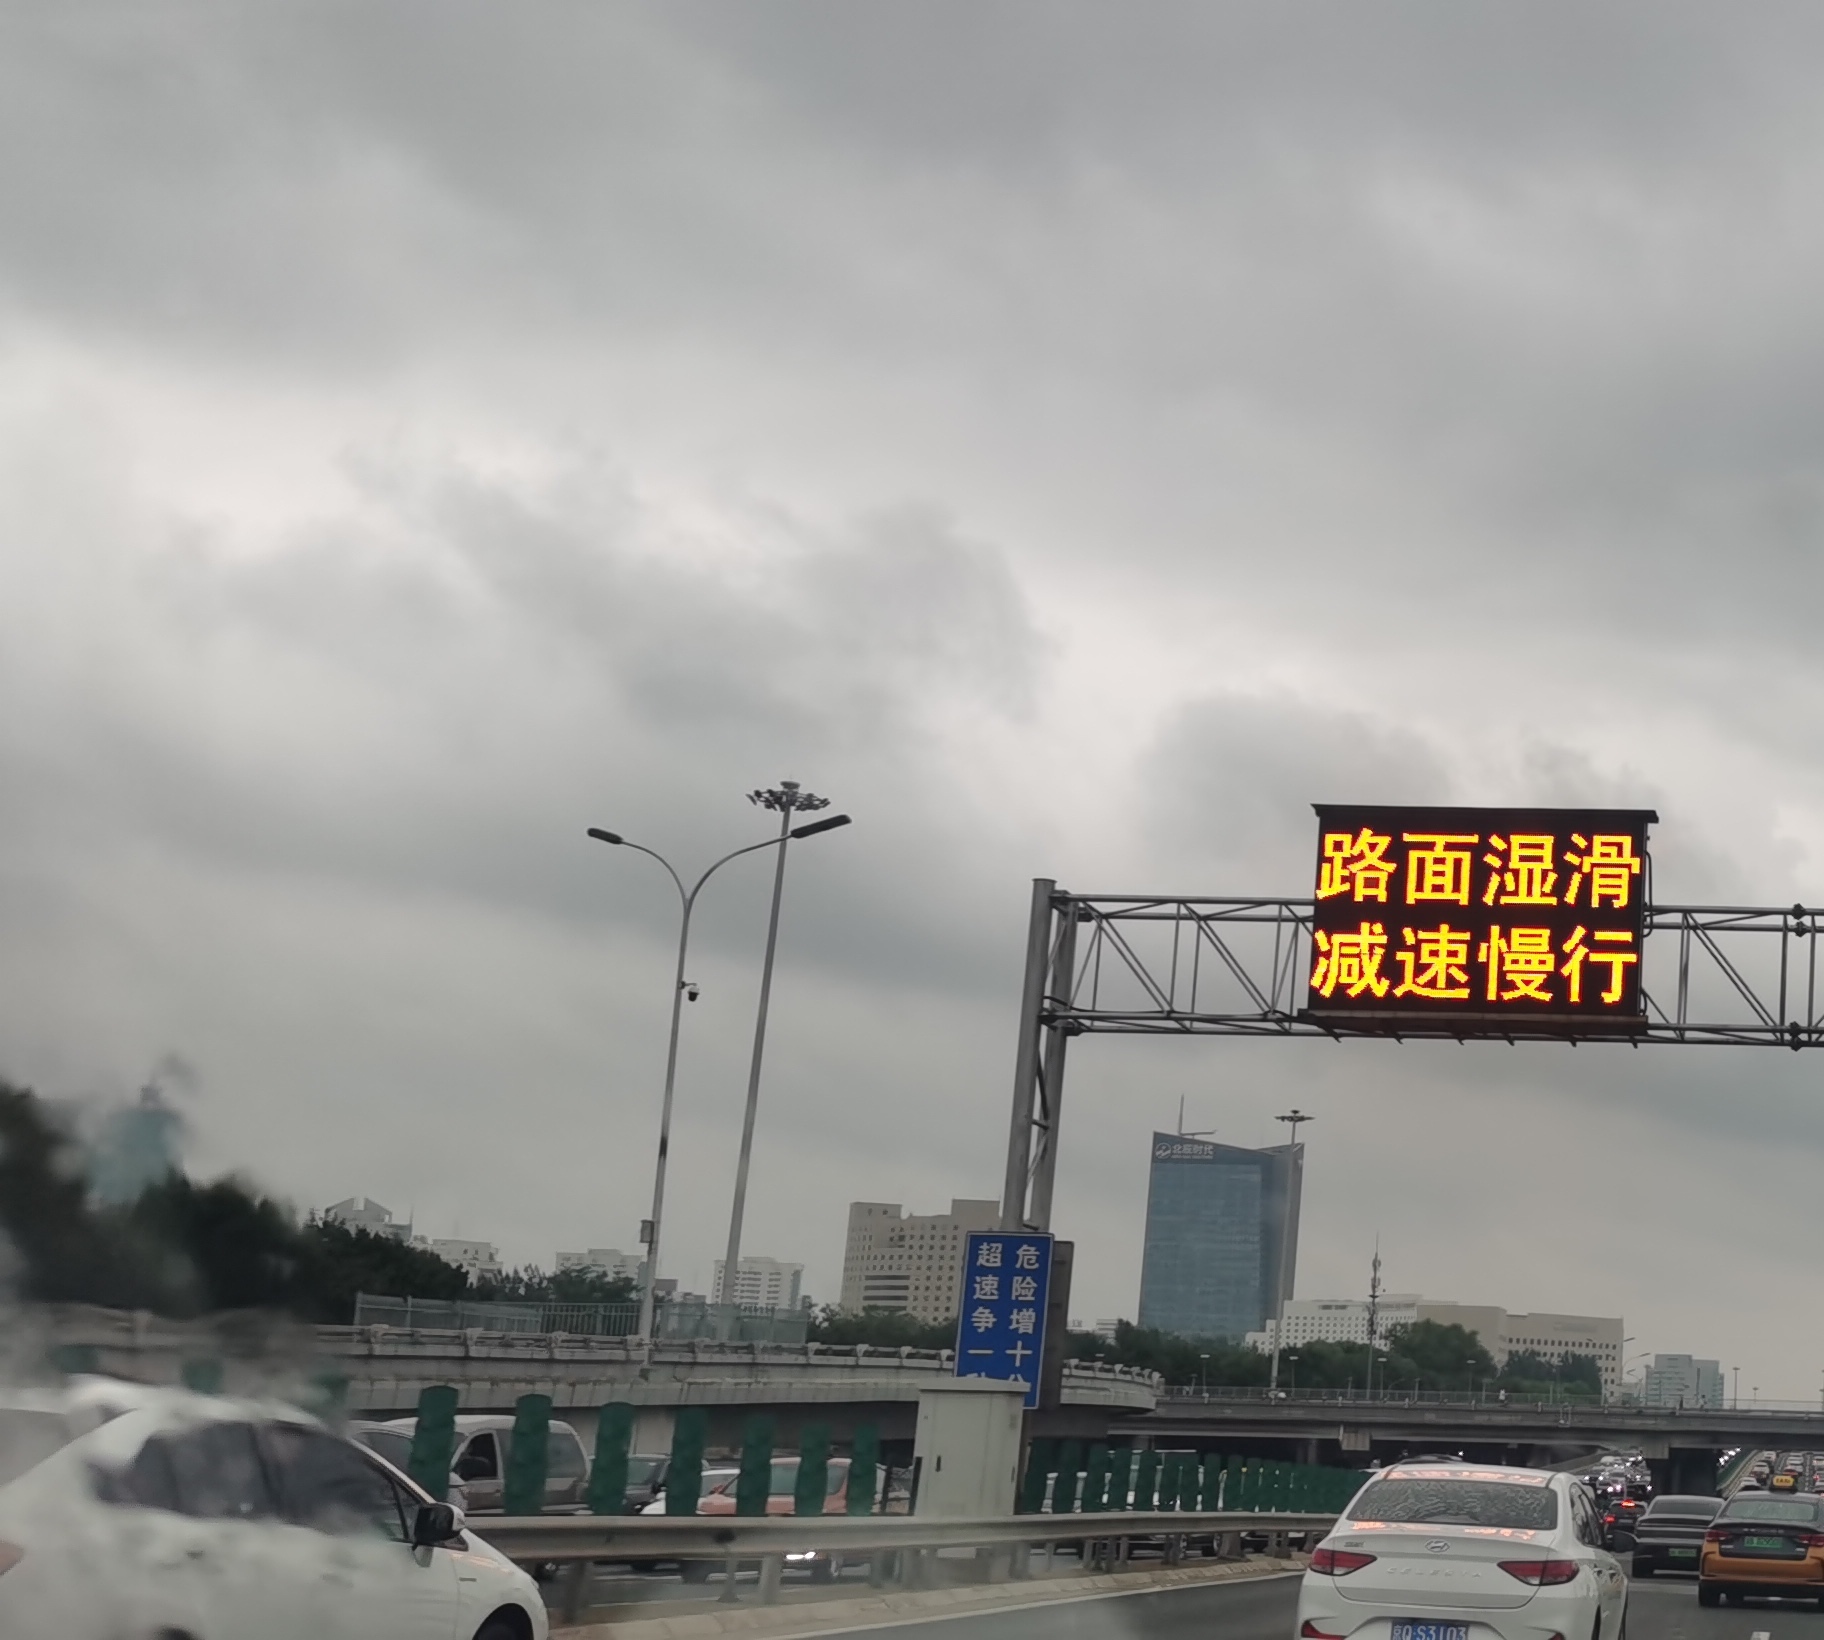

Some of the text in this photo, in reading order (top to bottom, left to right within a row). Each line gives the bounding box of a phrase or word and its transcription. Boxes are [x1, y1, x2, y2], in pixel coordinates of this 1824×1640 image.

[1316, 827, 1640, 908] 路面湿滑
[1310, 921, 1637, 1003] 减速慢行
[967, 1242, 1003, 1379] 超速争一
